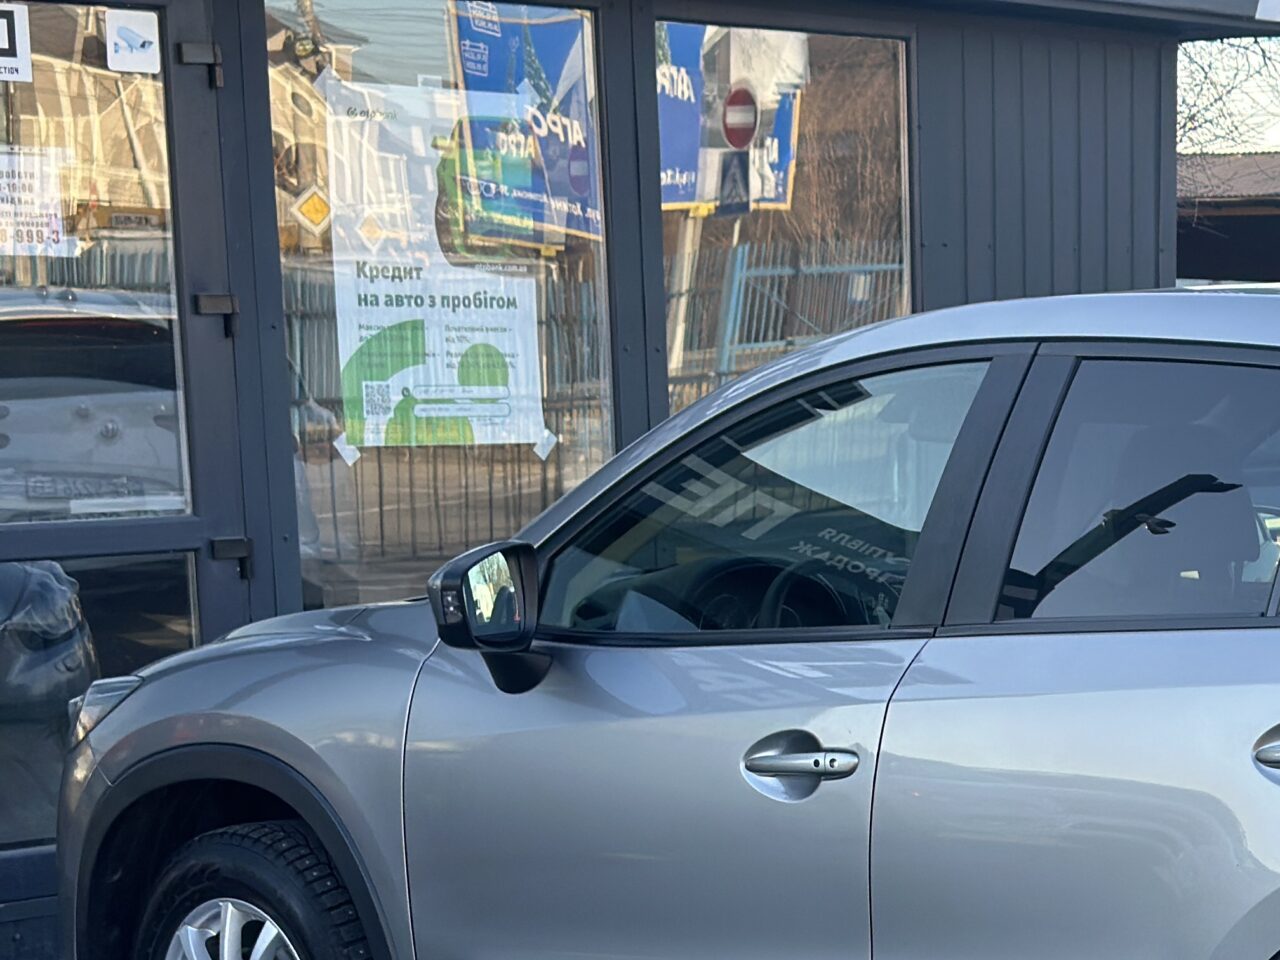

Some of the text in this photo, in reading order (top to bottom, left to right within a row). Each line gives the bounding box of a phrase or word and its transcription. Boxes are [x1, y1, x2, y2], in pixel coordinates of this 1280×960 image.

[356, 261, 424, 284] Кредит
[357, 290, 518, 313] на авто з пробігом
